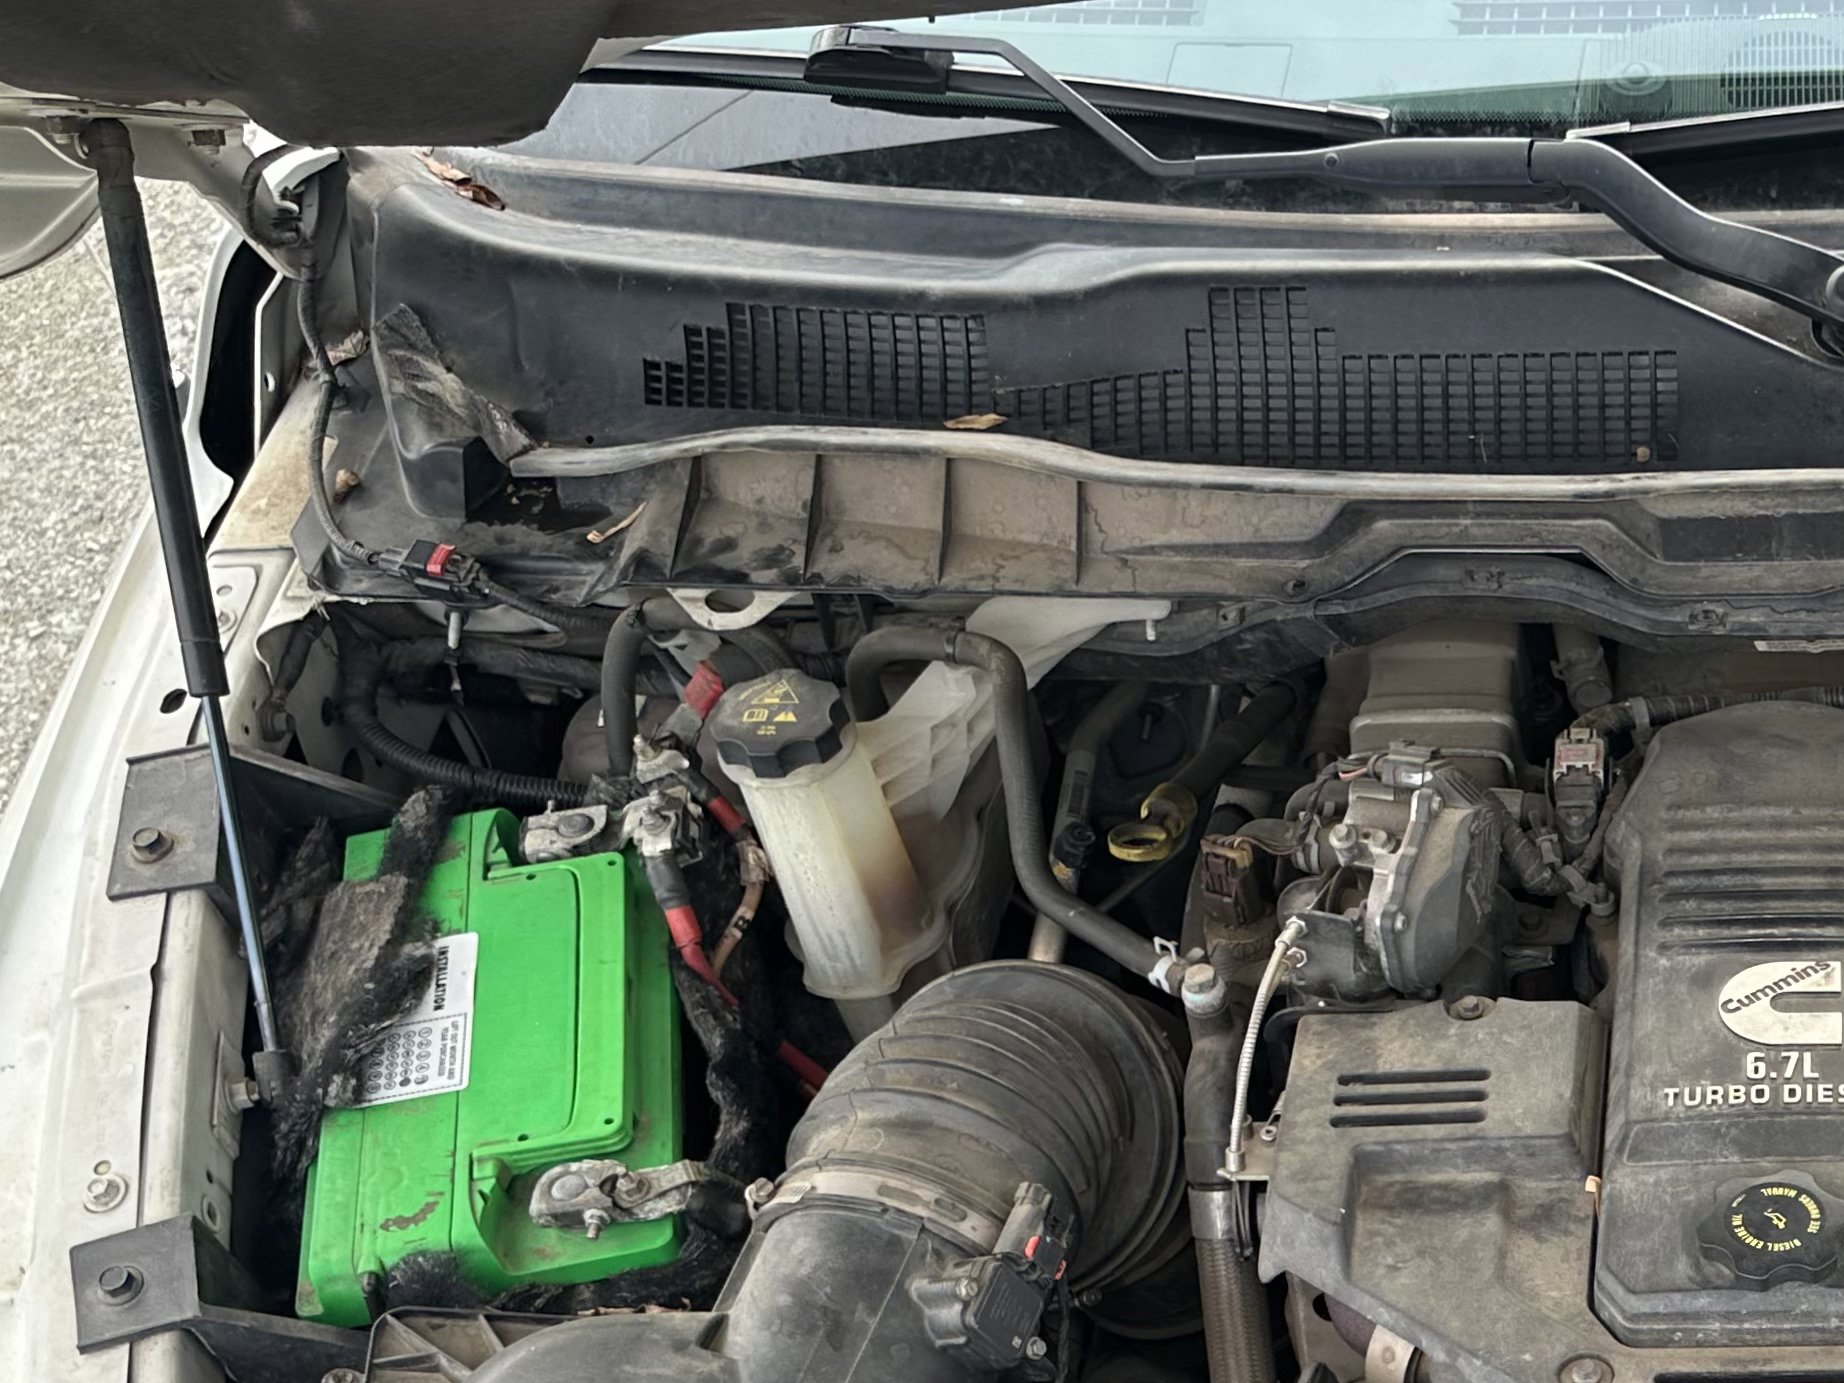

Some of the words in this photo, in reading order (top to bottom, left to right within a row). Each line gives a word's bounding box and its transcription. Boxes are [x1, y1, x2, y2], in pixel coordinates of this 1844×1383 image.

[433, 945, 449, 1011] INSTALLATION
[1720, 960, 1831, 1014] Cummins
[1746, 1051, 1820, 1080] 6.7L
[1663, 1084, 1770, 1107] TURBO
[1767, 1238, 1802, 1252] DIESEL
